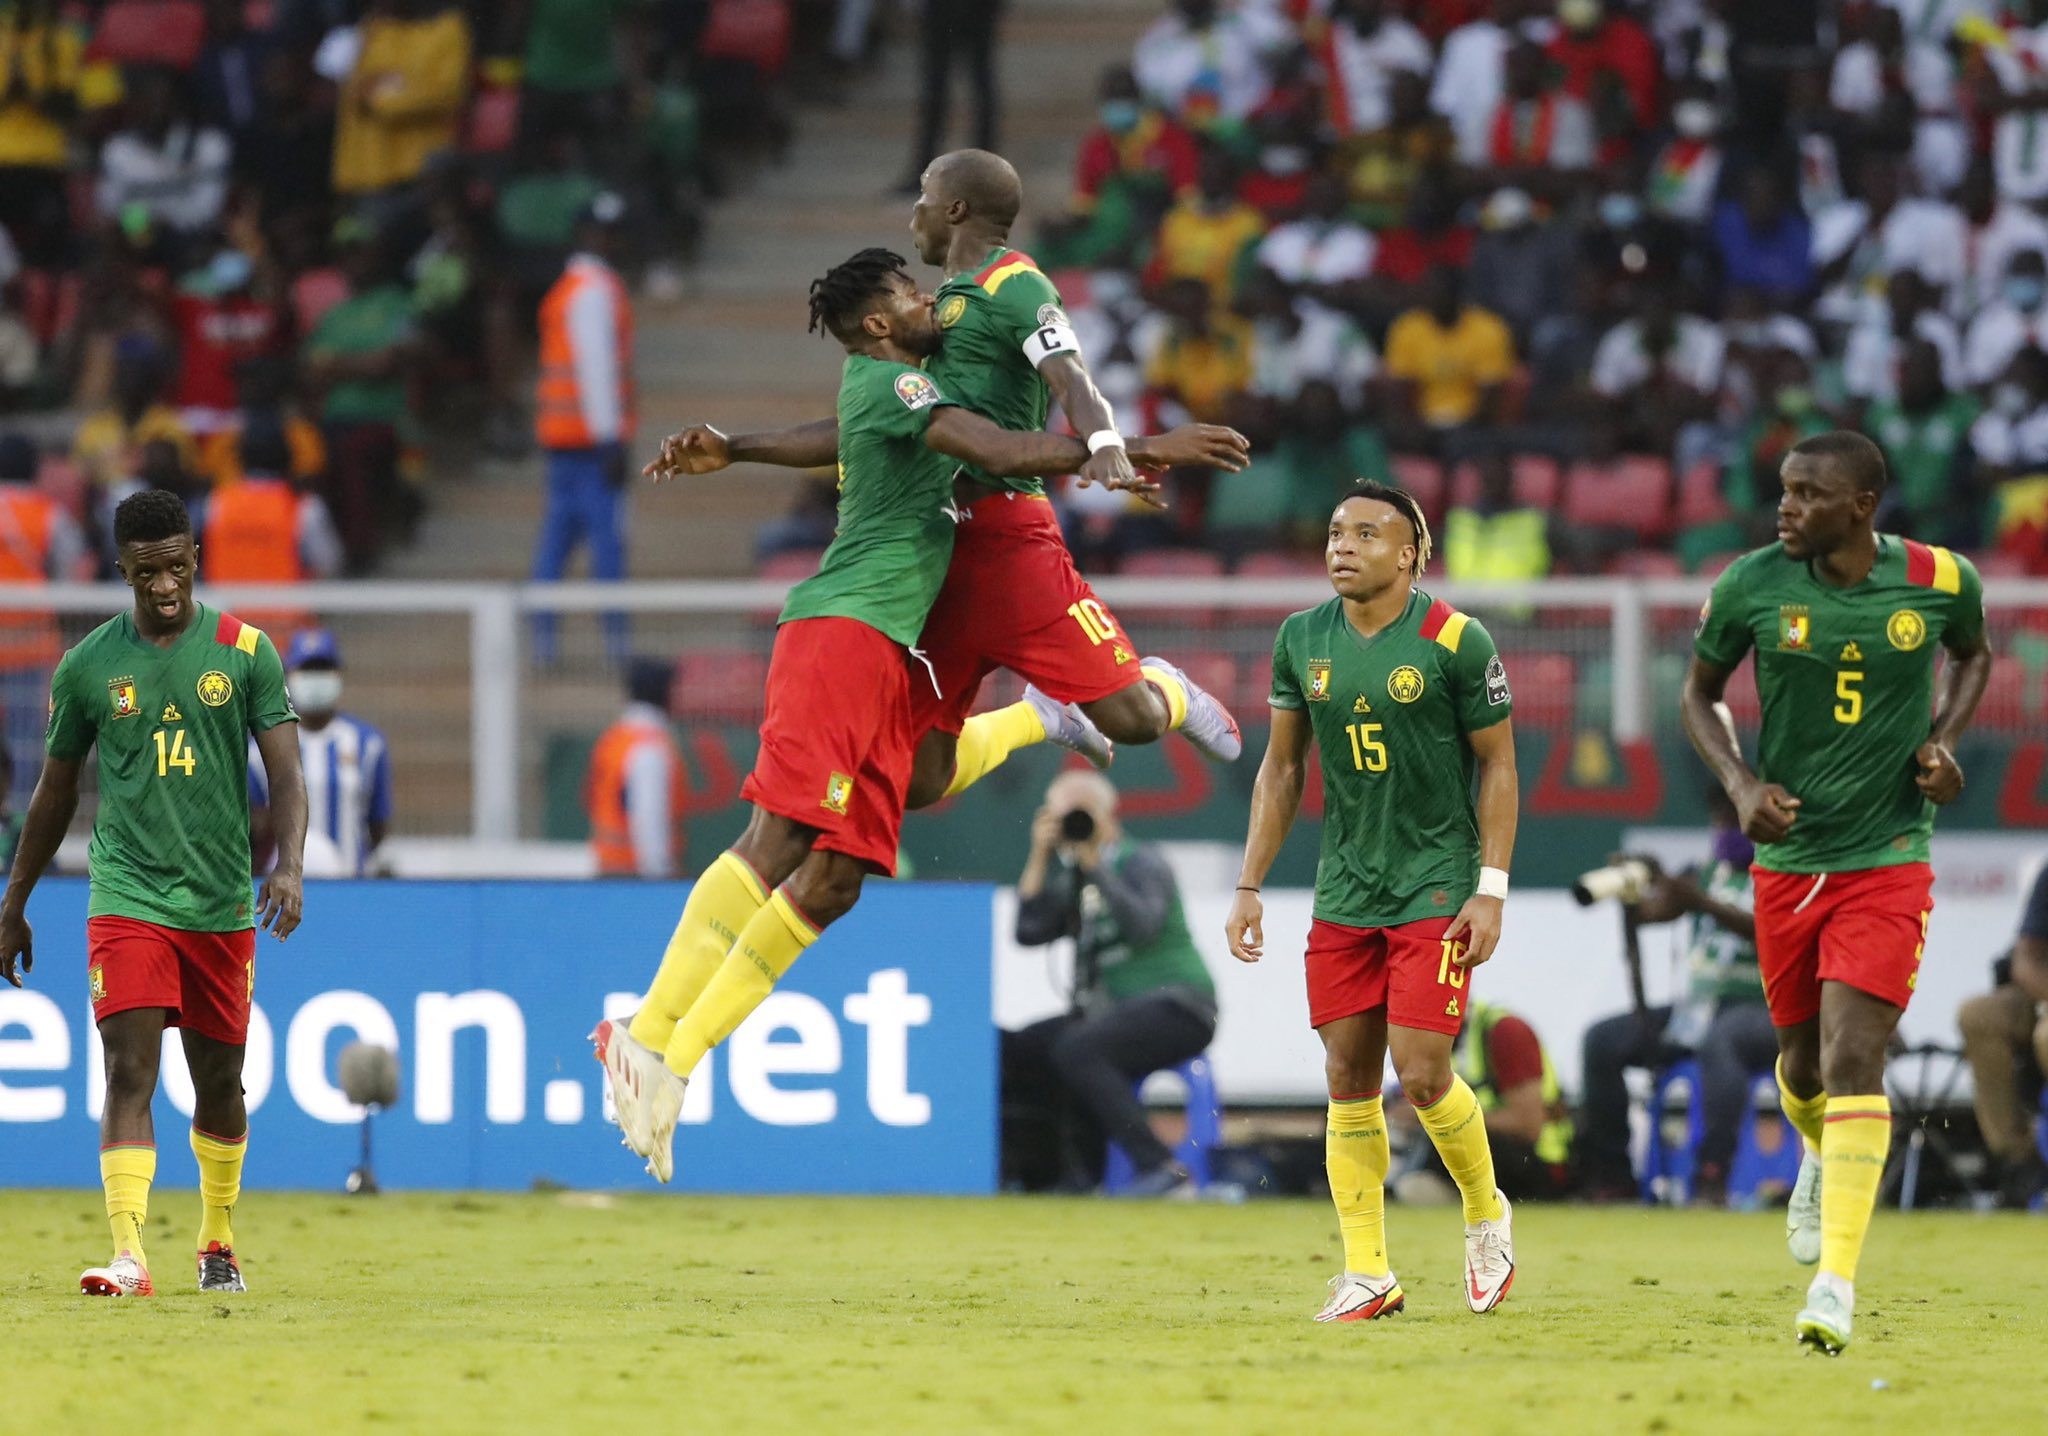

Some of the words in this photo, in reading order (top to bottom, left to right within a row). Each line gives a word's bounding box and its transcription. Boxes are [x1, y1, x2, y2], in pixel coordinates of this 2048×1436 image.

[1037, 327, 1061, 351] C
[1066, 598, 1117, 647] 10
[1834, 671, 1864, 724] 5
[153, 729, 196, 777] 14
[1345, 723, 1388, 772] 15
